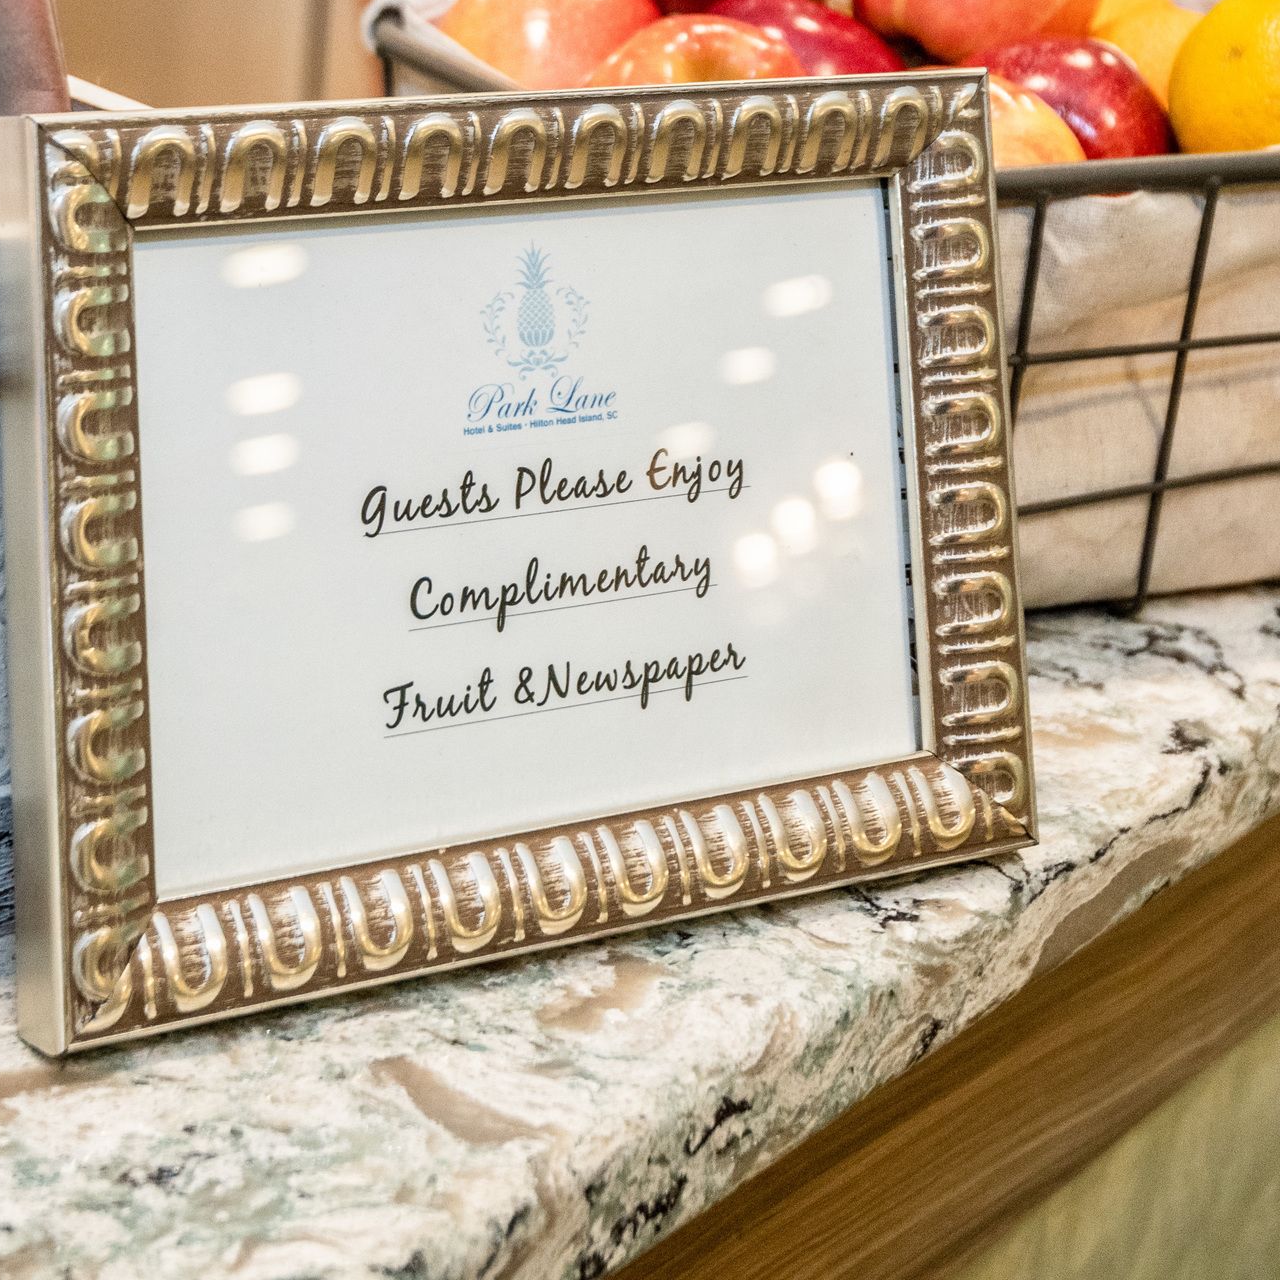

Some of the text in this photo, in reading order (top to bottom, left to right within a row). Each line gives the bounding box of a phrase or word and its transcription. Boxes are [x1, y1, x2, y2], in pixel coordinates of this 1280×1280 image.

[463, 423, 486, 436] Hotel
[487, 425, 494, 433] &
[496, 422, 522, 432] Suites
[529, 418, 554, 429] Hilton
[556, 416, 577, 426] Head
[606, 410, 618, 420] SC
[467, 375, 617, 423] Park Lane
[360, 447, 745, 538] Guests Please Enjoy
[409, 545, 711, 632] Complimentary
[382, 668, 497, 730] Fruit
